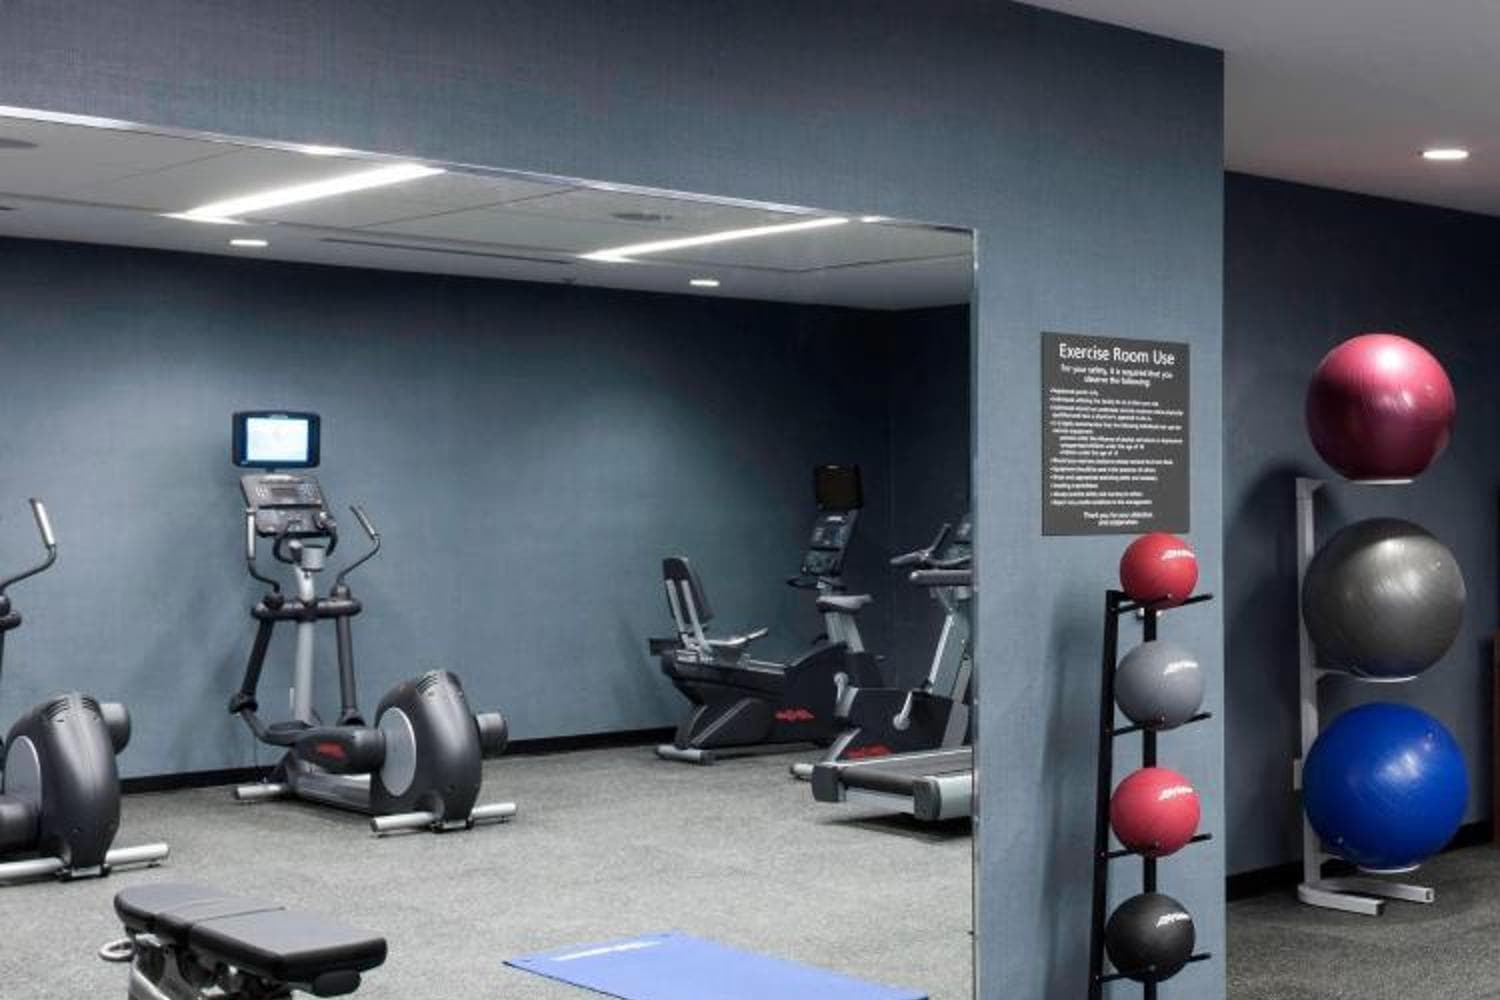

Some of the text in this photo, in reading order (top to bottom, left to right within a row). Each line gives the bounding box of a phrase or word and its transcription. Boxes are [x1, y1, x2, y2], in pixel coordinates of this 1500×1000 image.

[1059, 343, 1175, 365] Exercise Room Use
